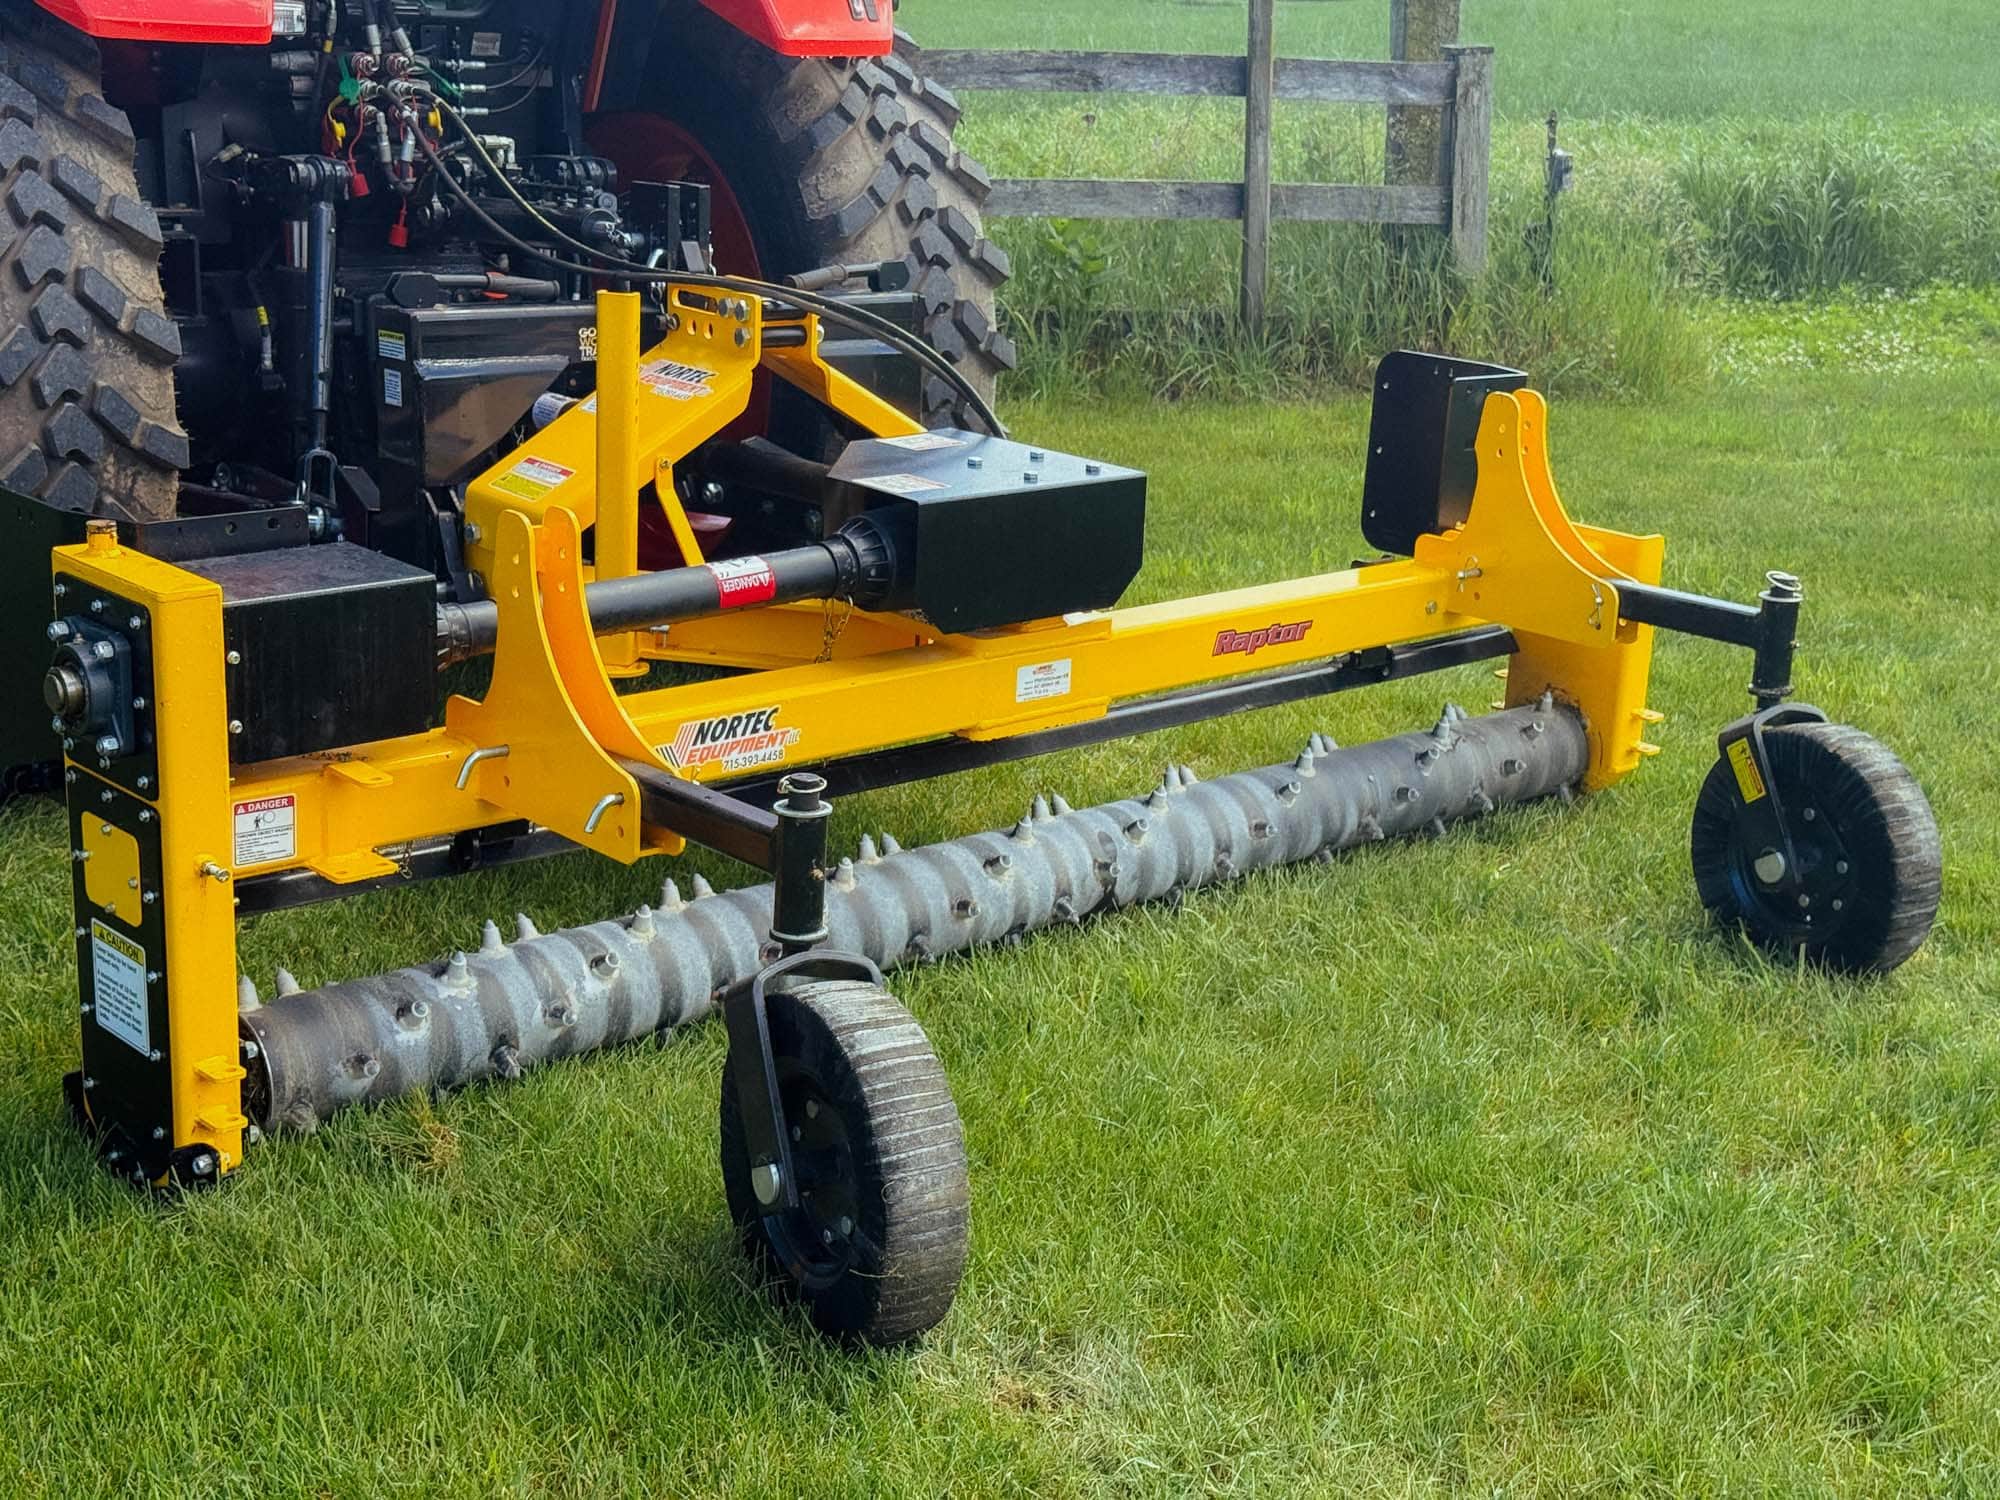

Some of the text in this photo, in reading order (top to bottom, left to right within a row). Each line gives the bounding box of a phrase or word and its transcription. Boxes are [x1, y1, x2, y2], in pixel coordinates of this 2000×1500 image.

[722, 574, 761, 593] DANGER
[1212, 620, 1313, 656] Raptor
[692, 707, 780, 746] NORTEC
[685, 730, 790, 765] EQUIPMENT
[723, 750, 784, 770] 715-393-4458
[247, 798, 289, 812] DANGER
[105, 931, 139, 961] CAUTION
